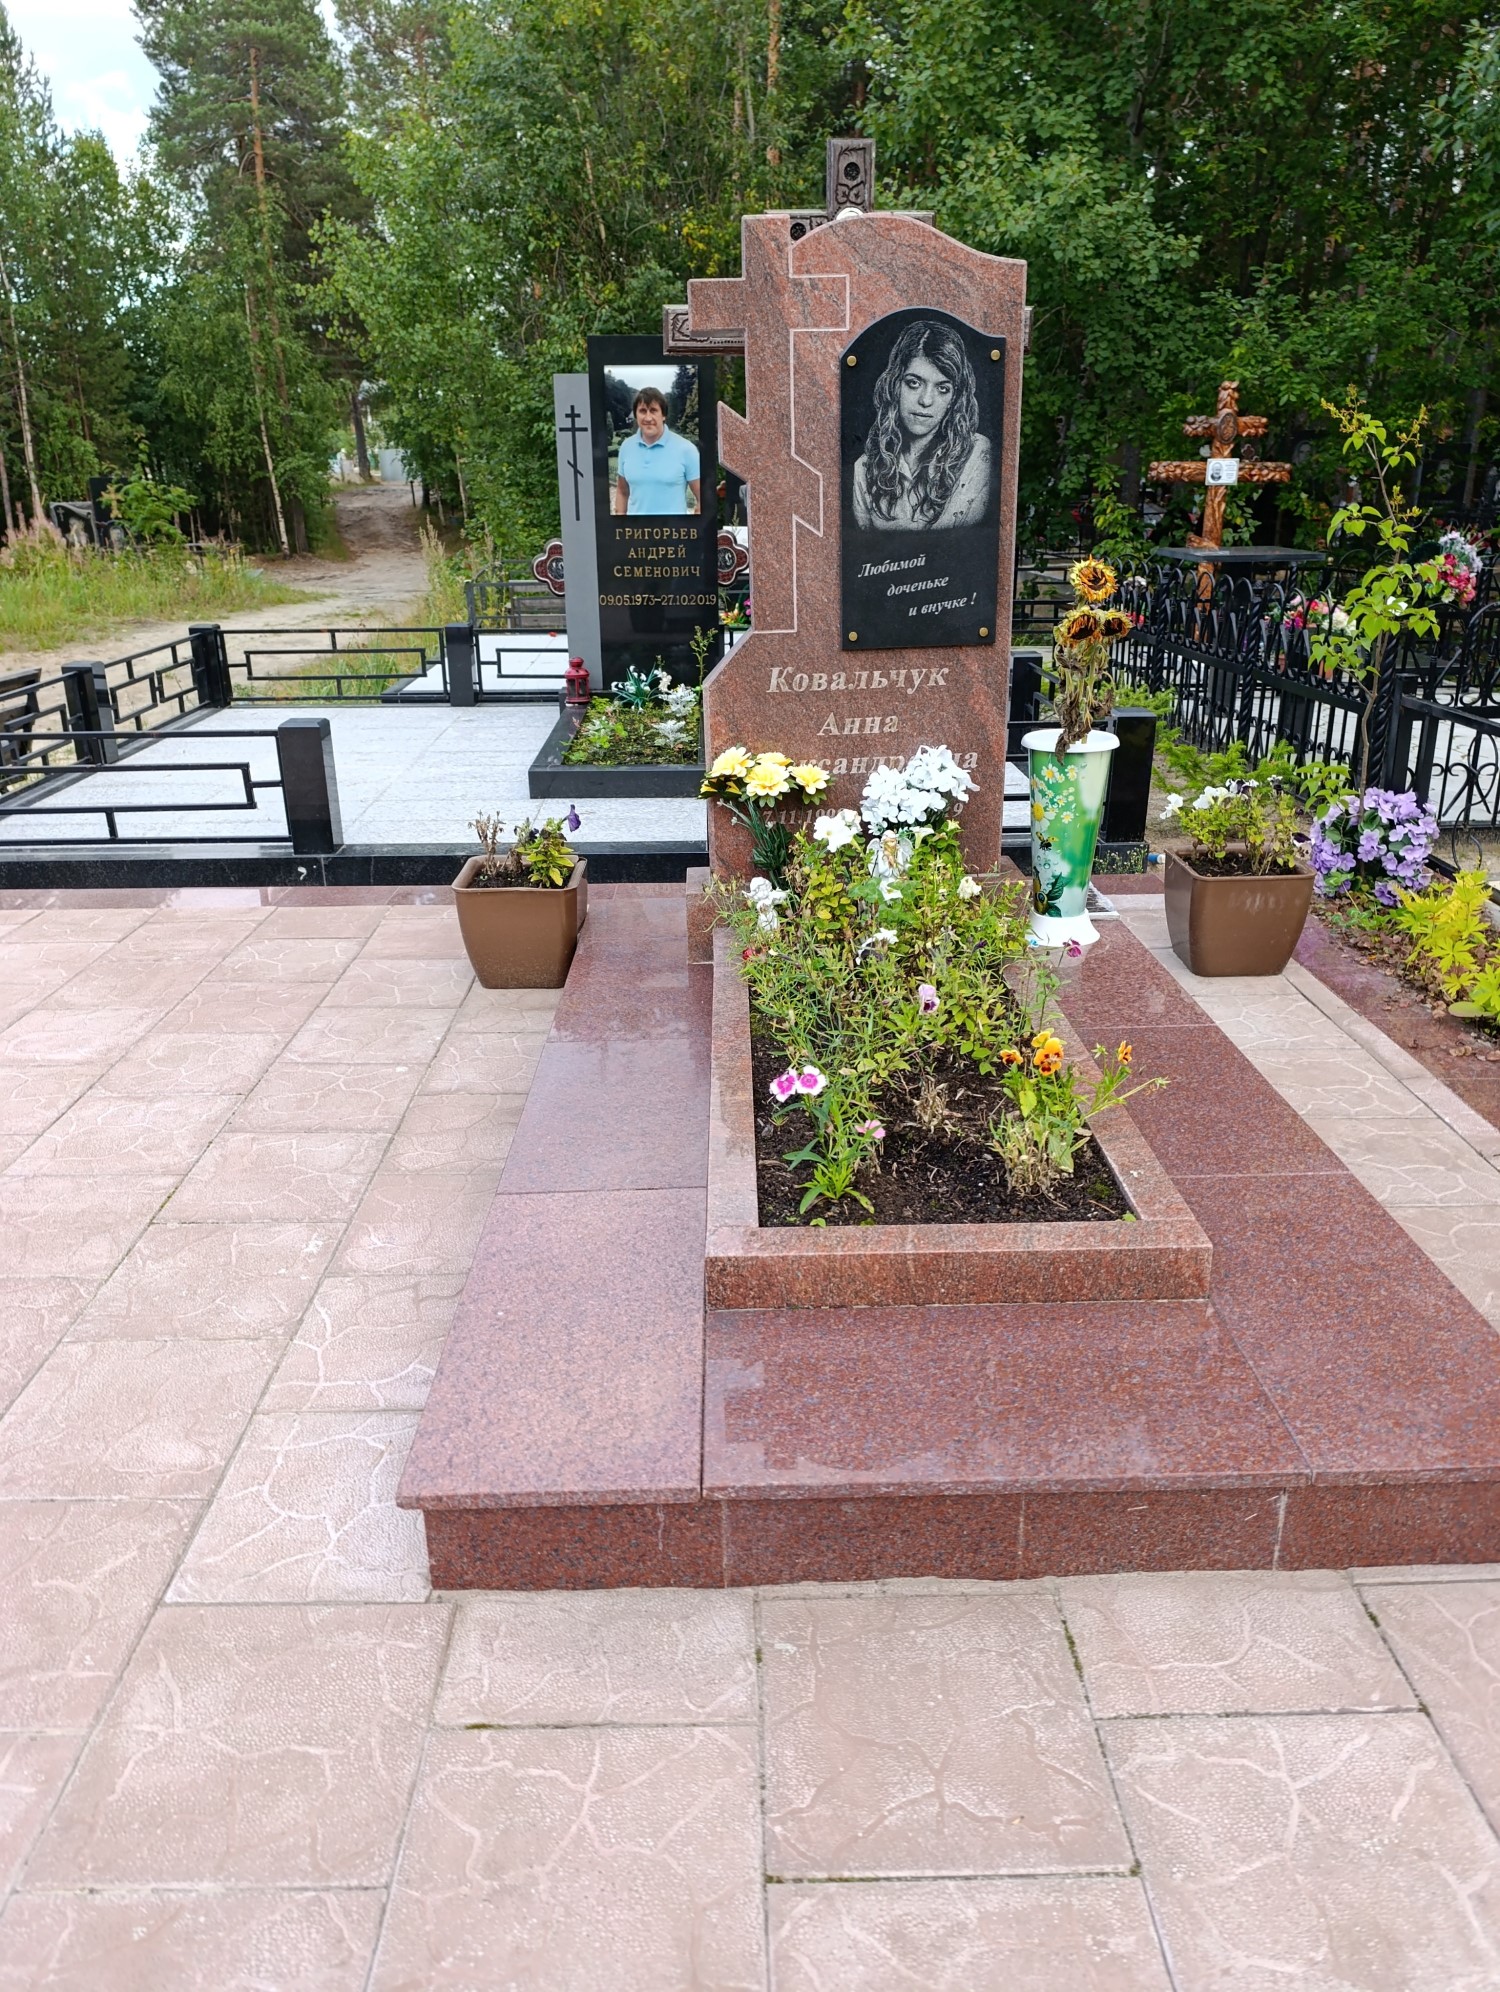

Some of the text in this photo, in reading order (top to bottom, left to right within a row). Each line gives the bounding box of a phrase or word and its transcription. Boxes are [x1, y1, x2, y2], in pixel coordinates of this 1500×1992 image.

[615, 528, 698, 540] ГРИГОРЬЕВ
[628, 545, 687, 560] АНДРЕЙ
[613, 566, 700, 578] СЕМЕНОВИЧ
[857, 554, 926, 577] Любимой
[887, 576, 949, 596] доченьке
[908, 607, 917, 617] и
[920, 597, 967, 614] внучке
[766, 666, 949, 695] Ковальчук
[816, 711, 899, 736] Анна
